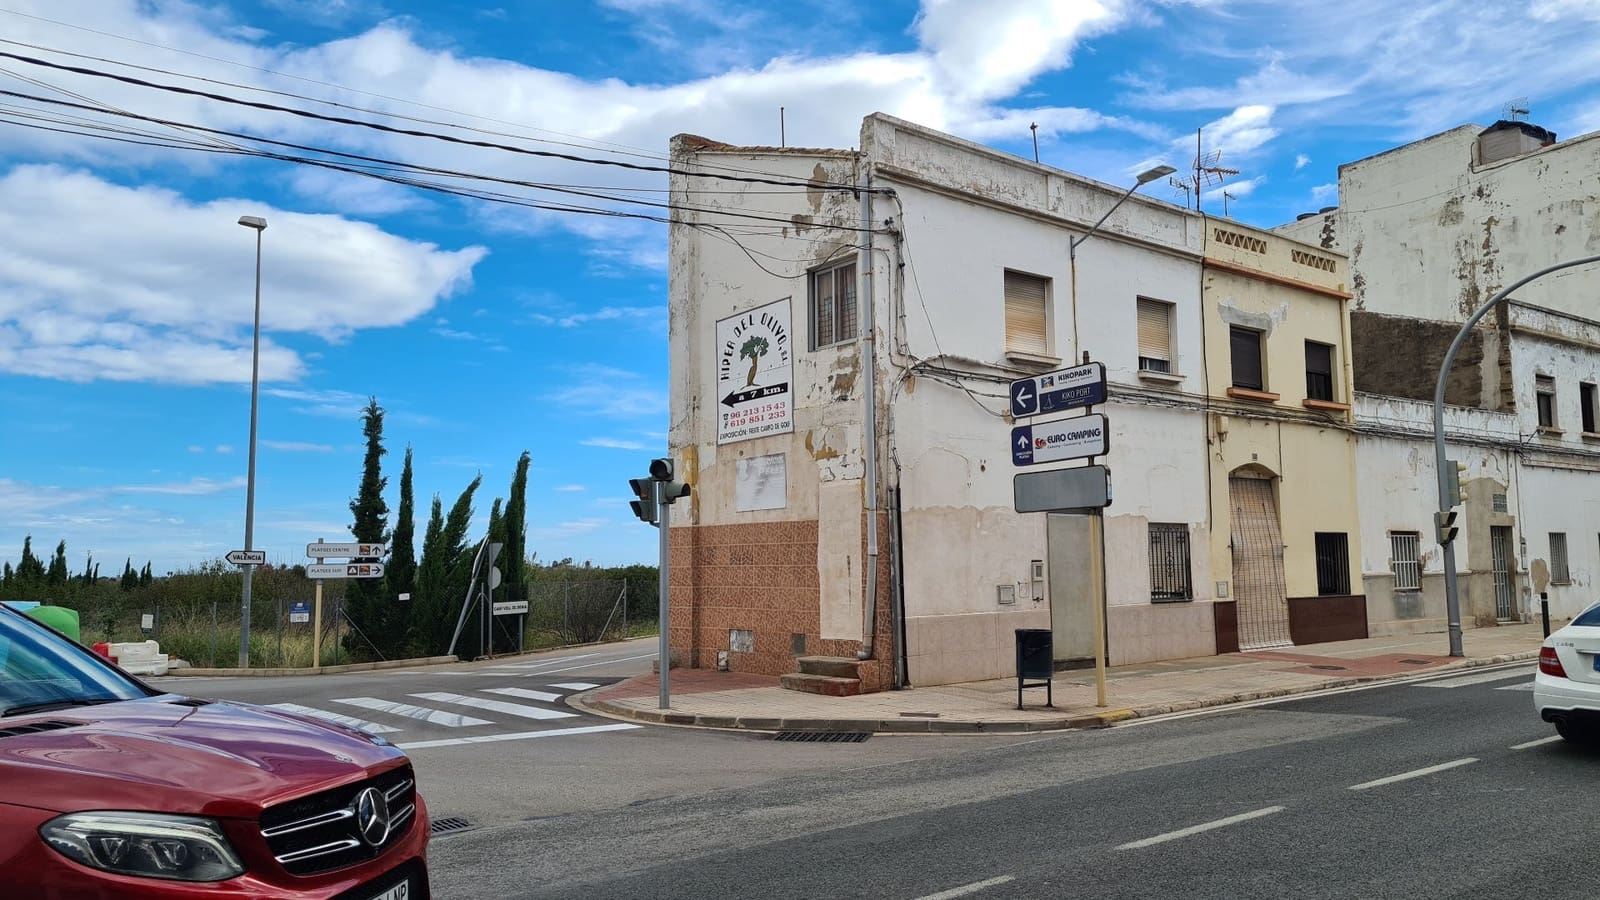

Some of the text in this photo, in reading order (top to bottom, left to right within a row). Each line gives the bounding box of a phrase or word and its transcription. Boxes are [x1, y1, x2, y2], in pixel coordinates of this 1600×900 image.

[720, 340, 736, 380] HIPER
[734, 314, 754, 338] DEL
[1058, 368, 1092, 381] KIKOPARK
[750, 390, 758, 398] 7
[763, 386, 784, 395] km.
[1062, 390, 1075, 400] KIKO
[730, 411, 741, 419] 96
[743, 407, 759, 417] 213
[730, 410, 786, 427] 619 851 233
[1047, 428, 1101, 443] EURO CAMPING
